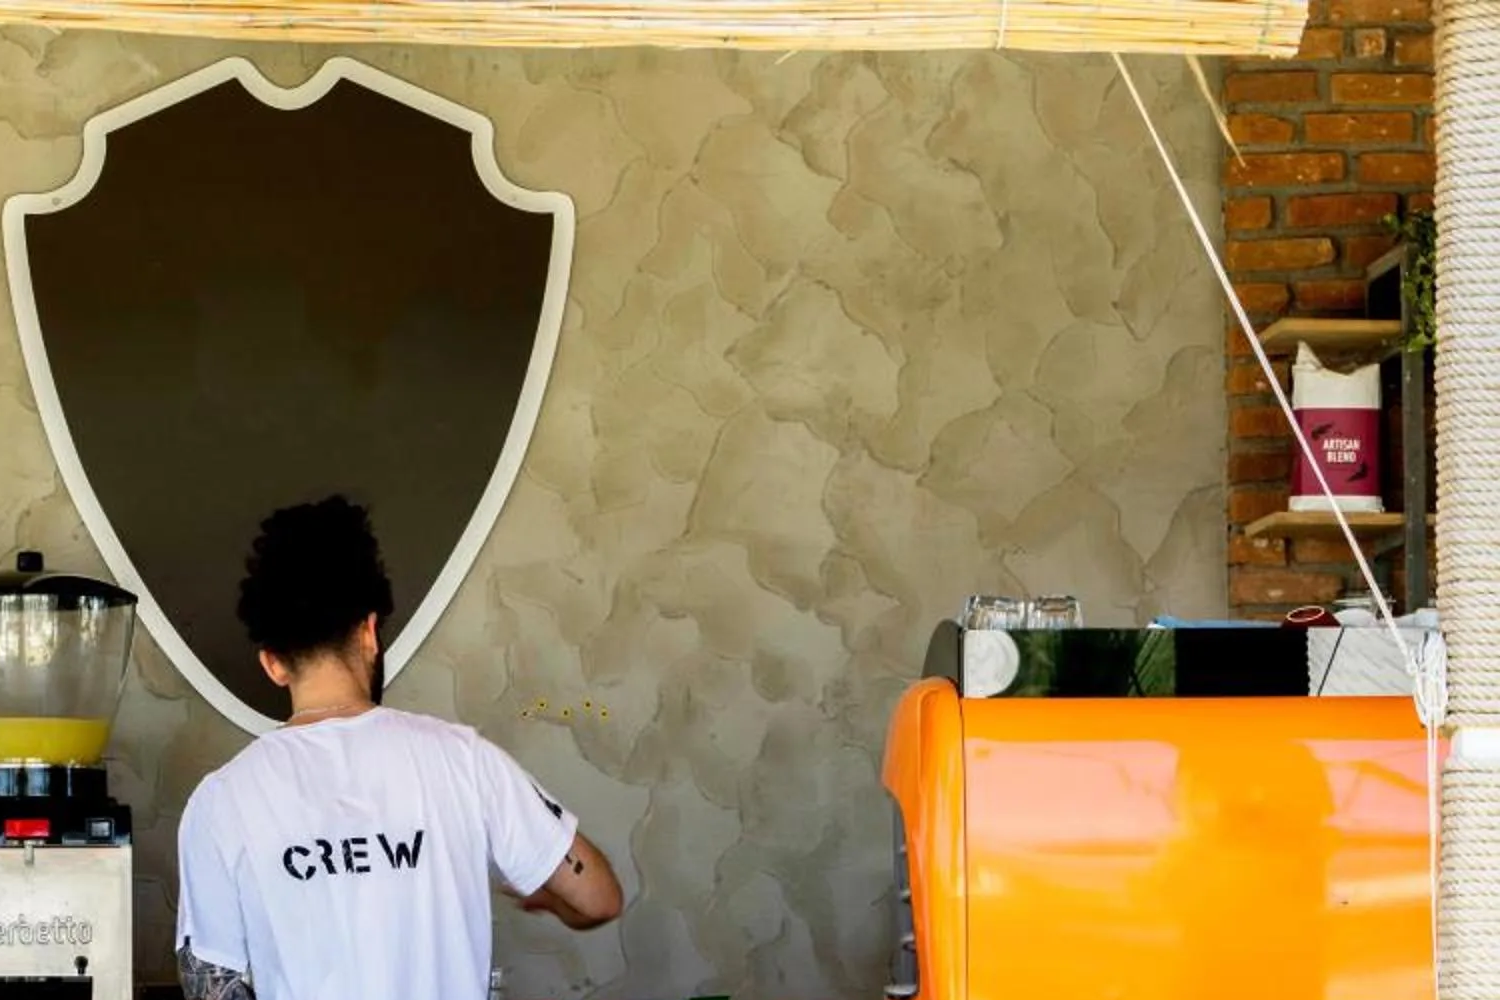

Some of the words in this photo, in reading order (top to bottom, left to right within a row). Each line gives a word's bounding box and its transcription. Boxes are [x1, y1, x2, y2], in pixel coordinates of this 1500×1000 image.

[1323, 438, 1360, 450] ARTISAN
[1327, 451, 1357, 463] BLEND
[283, 829, 424, 880] CREW
